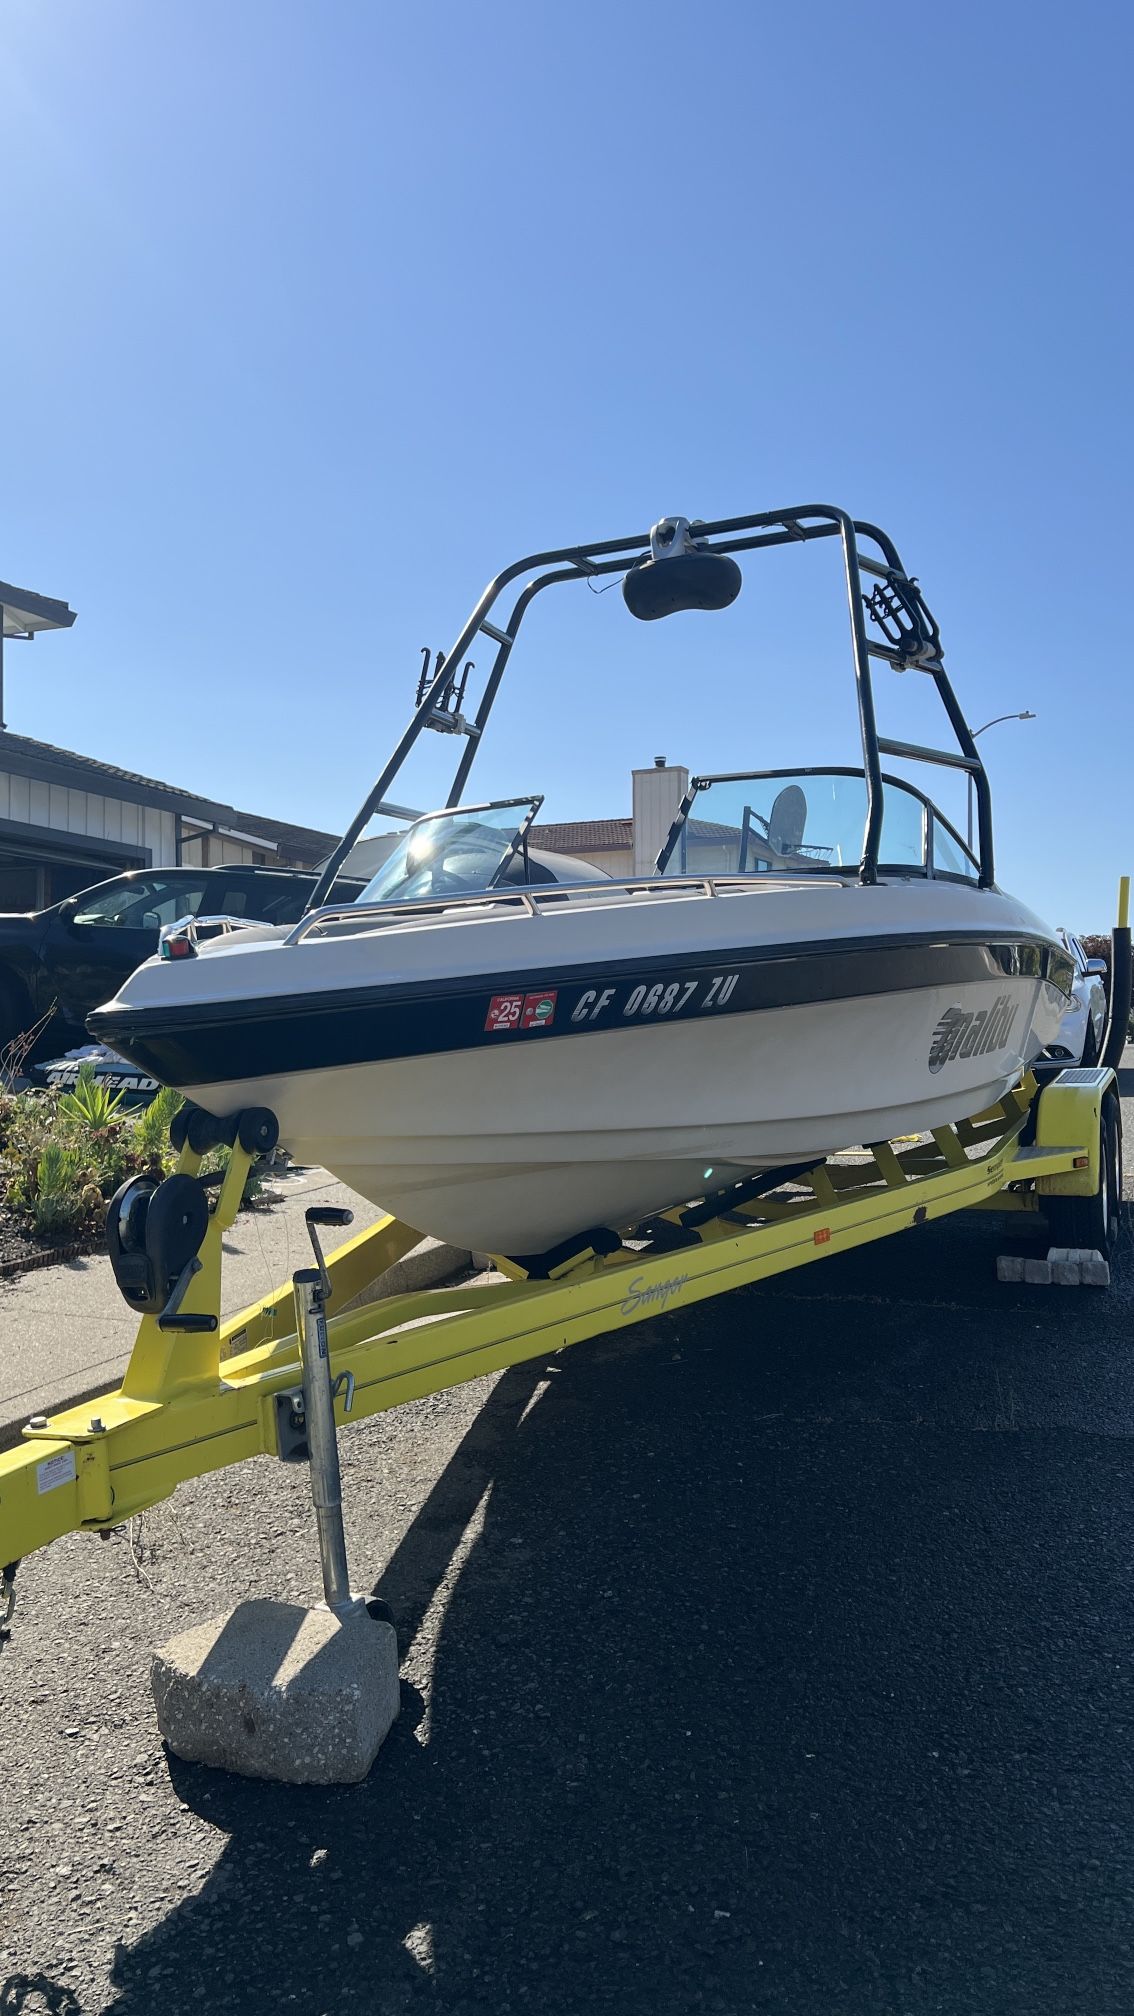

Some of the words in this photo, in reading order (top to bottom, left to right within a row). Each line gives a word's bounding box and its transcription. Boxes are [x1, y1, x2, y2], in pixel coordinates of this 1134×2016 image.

[498, 1001, 522, 1022] 25
[570, 989, 616, 1023] CF
[622, 981, 699, 1017] 0687
[701, 974, 740, 1008] ZU
[46, 1071, 160, 1091] AIRHEAD
[621, 1273, 689, 1316] Sanger
